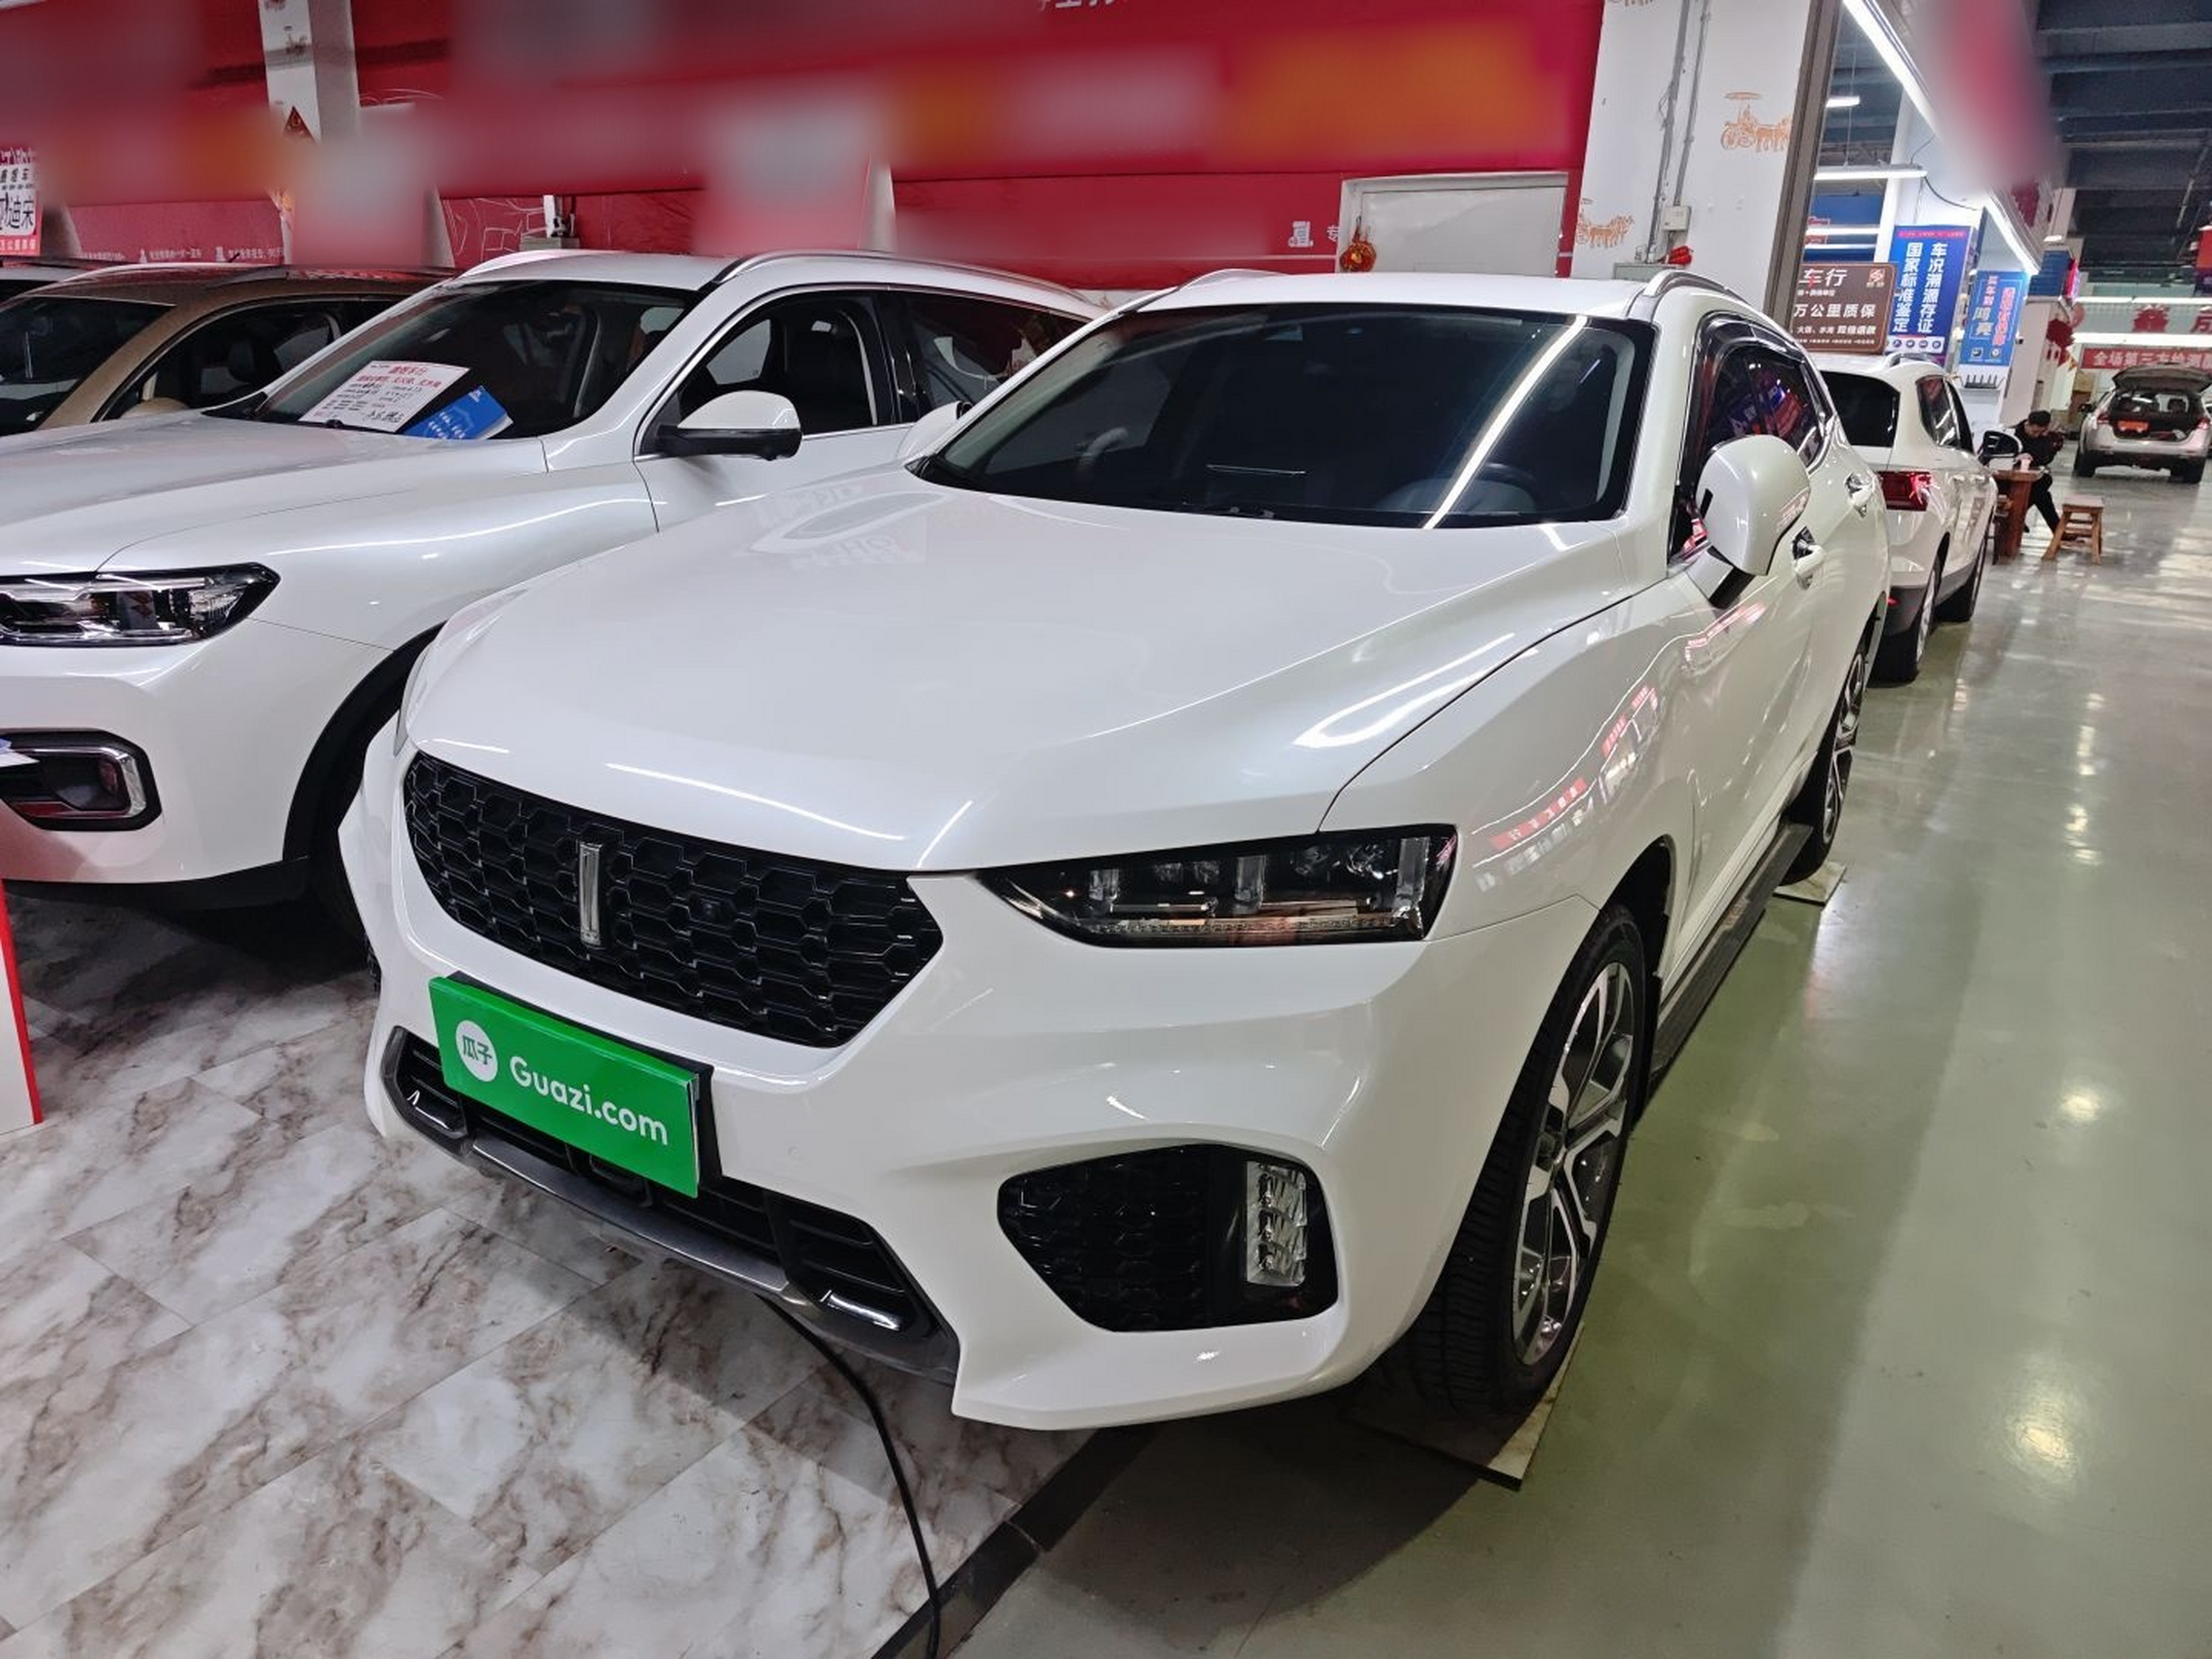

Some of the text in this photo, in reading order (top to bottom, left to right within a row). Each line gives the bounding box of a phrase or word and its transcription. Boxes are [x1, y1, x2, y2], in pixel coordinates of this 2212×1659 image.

[1798, 268, 1847, 286] 车行
[1893, 243, 1923, 332] 国家标准鉴定
[1917, 243, 1948, 333] 车况溯源存证
[1794, 304, 1876, 318] 万公里质保
[462, 1035, 493, 1066] 瓜子
[509, 1055, 668, 1146] Guazi.com
